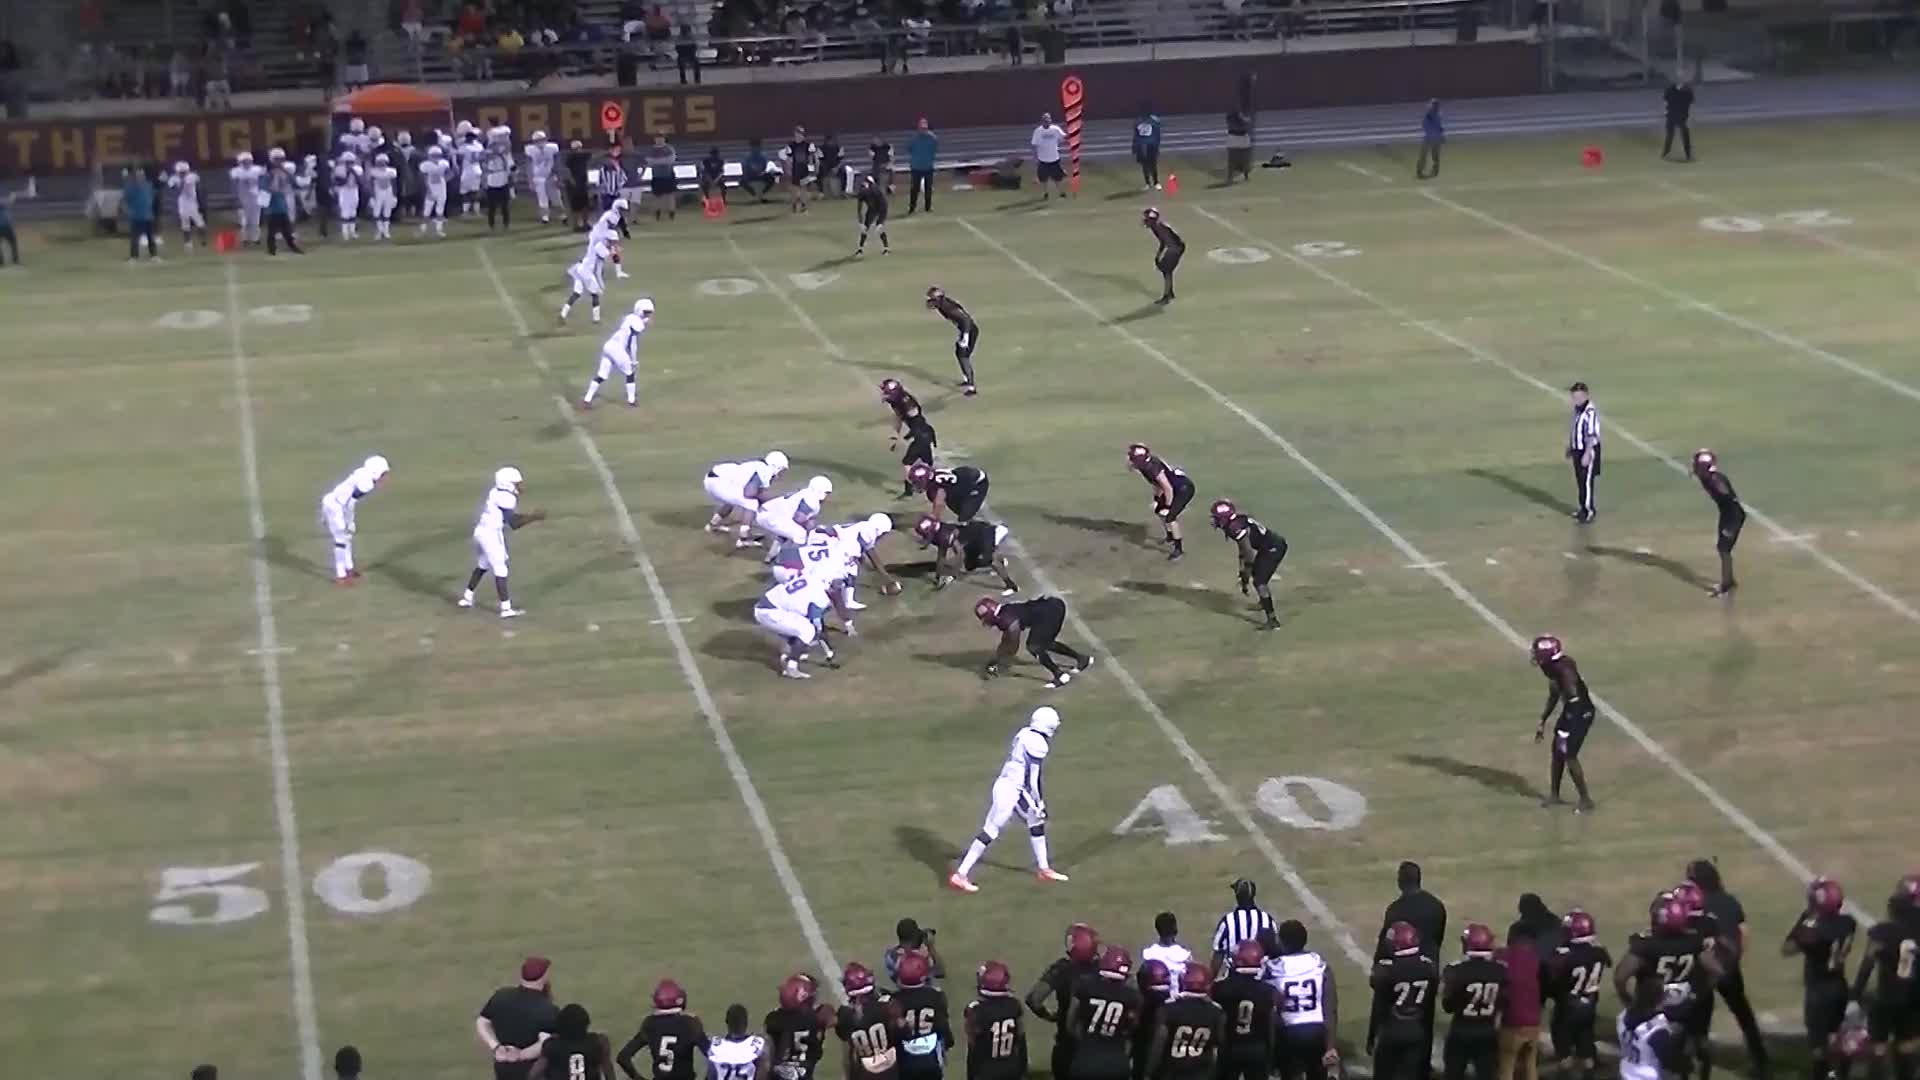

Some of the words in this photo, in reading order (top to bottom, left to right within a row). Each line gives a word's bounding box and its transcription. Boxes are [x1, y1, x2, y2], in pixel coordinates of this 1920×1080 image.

[8, 124, 126, 168] THE
[150, 850, 432, 925] 50
[1284, 978, 1317, 1013] 53
[656, 1035, 677, 1072] 5
[990, 1018, 1014, 1058] 16
